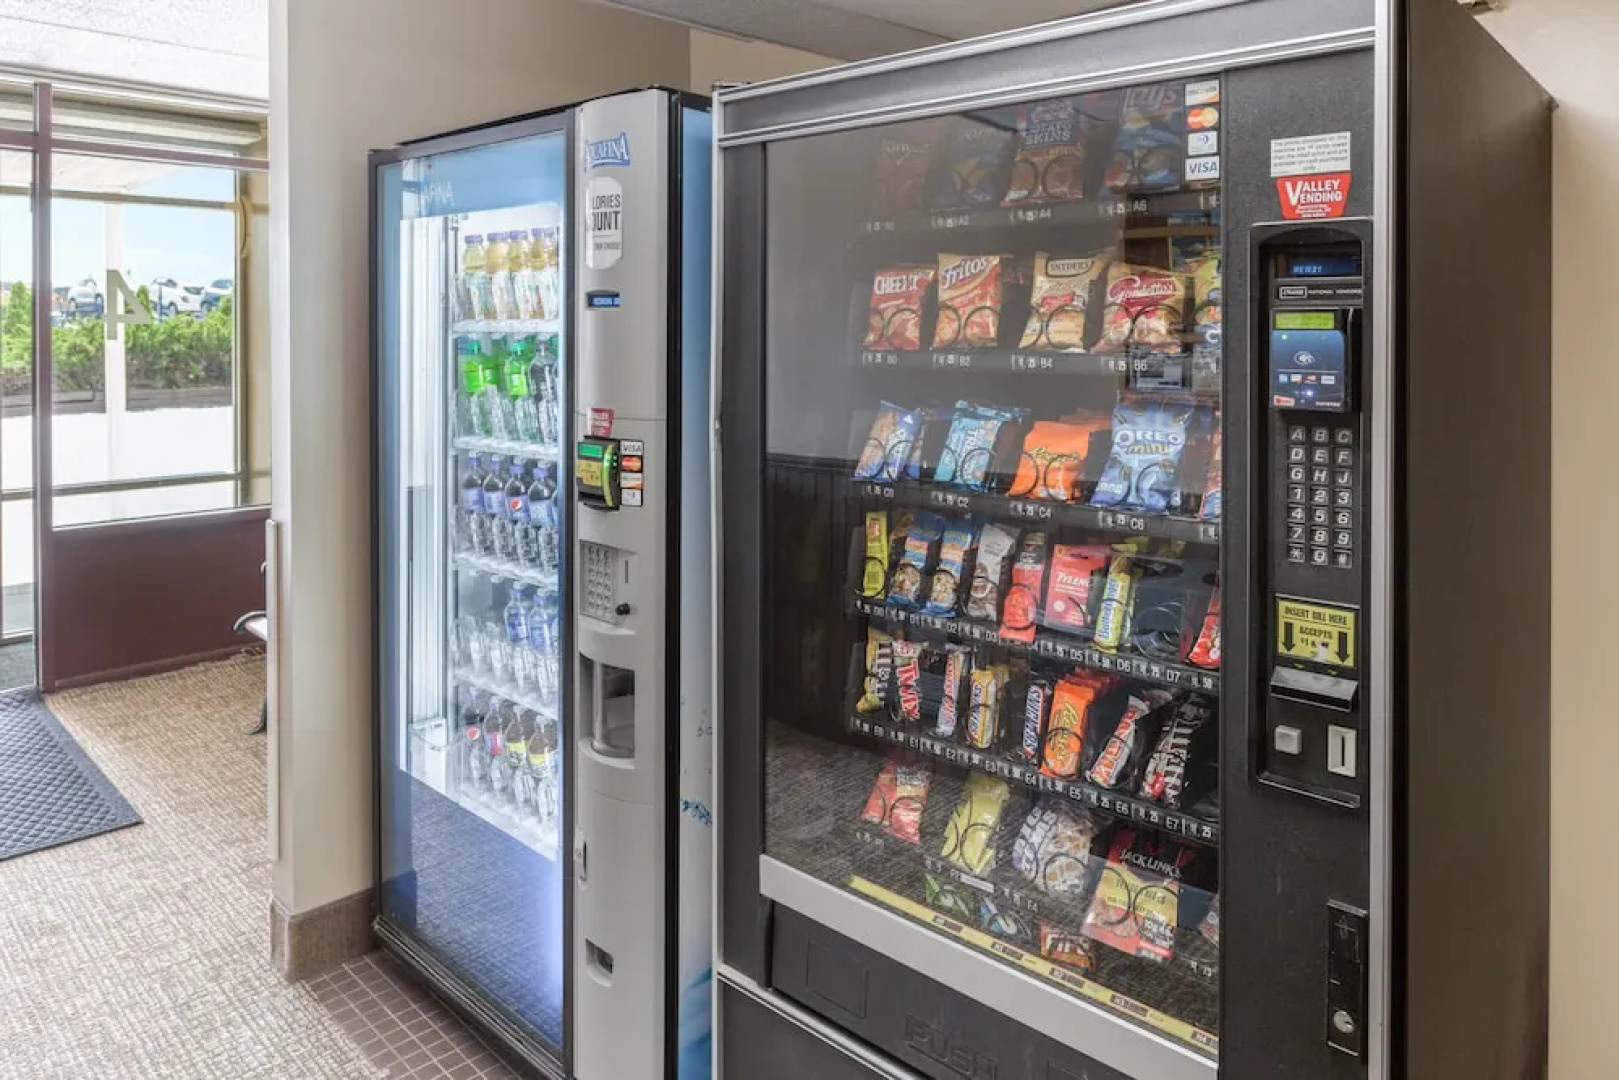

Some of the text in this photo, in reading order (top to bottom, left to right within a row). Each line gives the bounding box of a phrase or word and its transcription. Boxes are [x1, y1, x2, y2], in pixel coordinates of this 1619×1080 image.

[1024, 130, 1071, 144] SKINS
[1190, 162, 1218, 174] VISA
[1285, 179, 1341, 206] VALLEY
[591, 194, 621, 209] LORIES
[1114, 429, 1181, 447] OREO
[622, 444, 642, 453] VISA
[957, 495, 969, 508] C2
[1038, 505, 1051, 519] C4
[1130, 517, 1144, 531] C6
[1285, 606, 1347, 625] INSERT BILL HERE
[946, 621, 957, 633] D2
[1300, 625, 1332, 640] ACCEPTS
[986, 630, 997, 642] D3
[1070, 649, 1084, 662] D5
[1116, 658, 1131, 672] D6
[1166, 669, 1181, 683] D7
[1025, 772, 1037, 785] E4
[1070, 786, 1082, 800] E5
[1115, 801, 1129, 815] E6
[1165, 815, 1180, 830] E7
[1120, 849, 1147, 868] JACK
